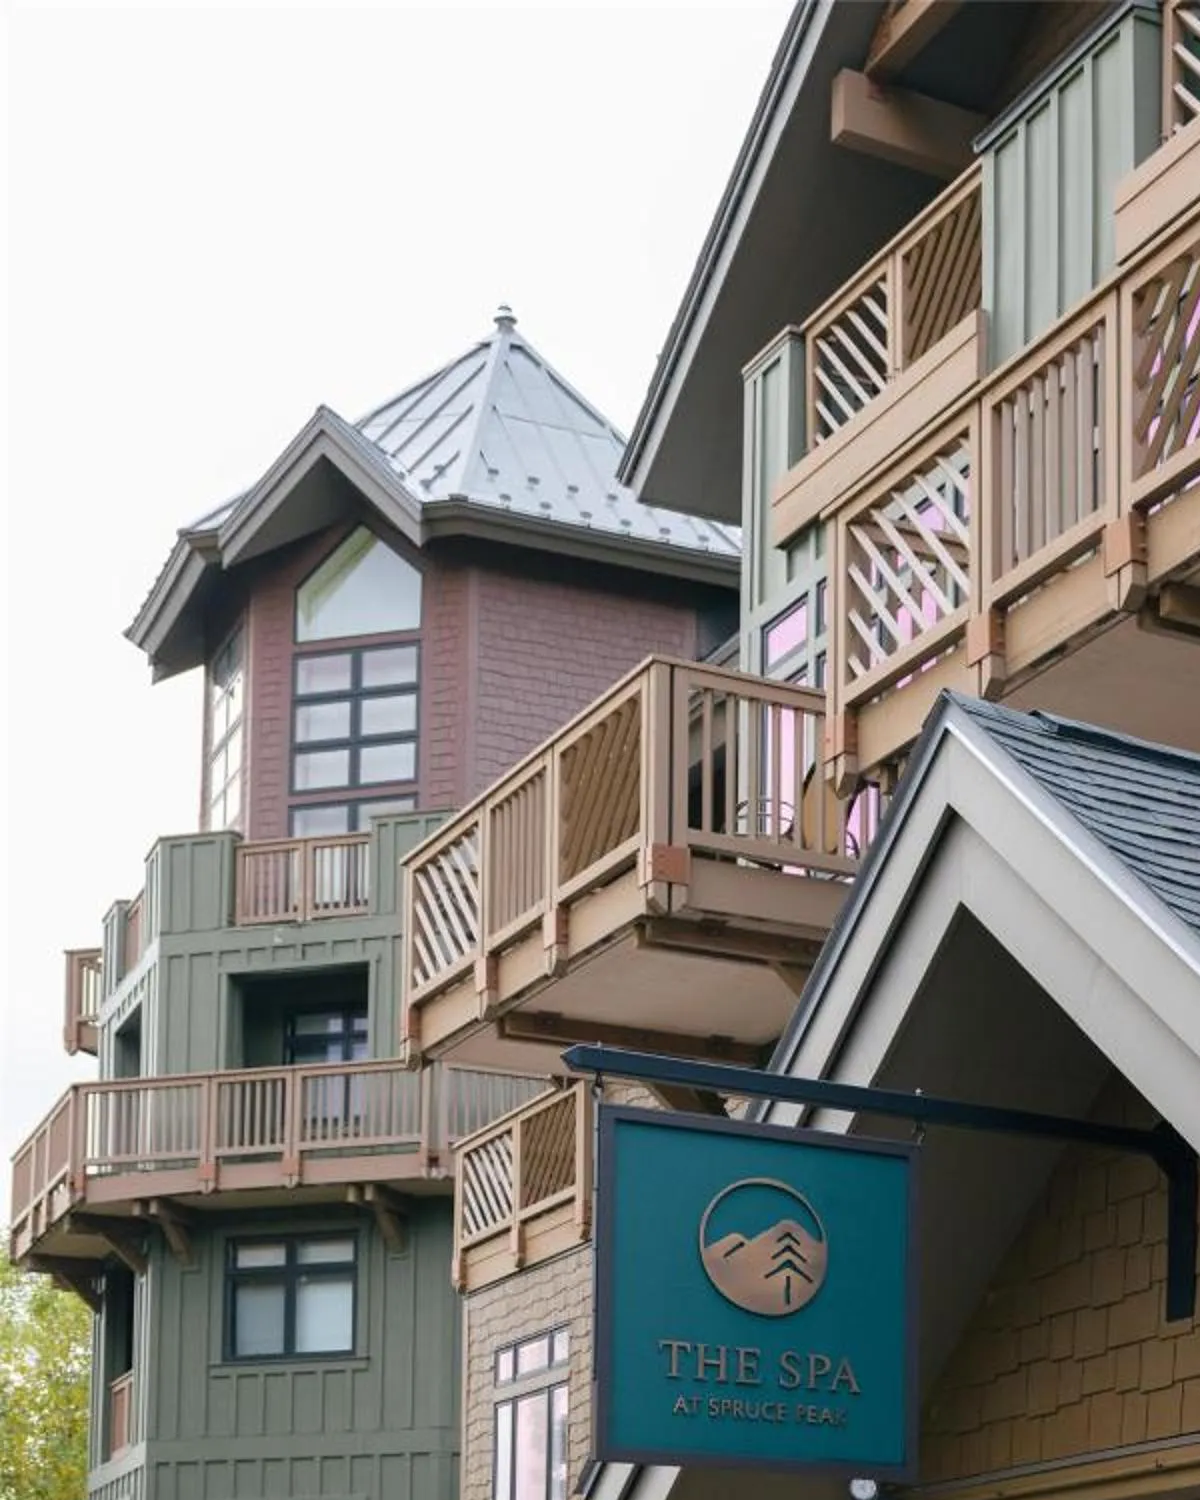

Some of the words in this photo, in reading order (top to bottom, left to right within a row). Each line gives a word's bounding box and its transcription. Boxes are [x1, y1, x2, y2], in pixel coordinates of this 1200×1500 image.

[658, 1338, 762, 1384] THE
[778, 1350, 861, 1393] SPA
[672, 1395, 702, 1416] AT
[708, 1396, 787, 1422] SPRUCE
[796, 1403, 848, 1427] PEAK
